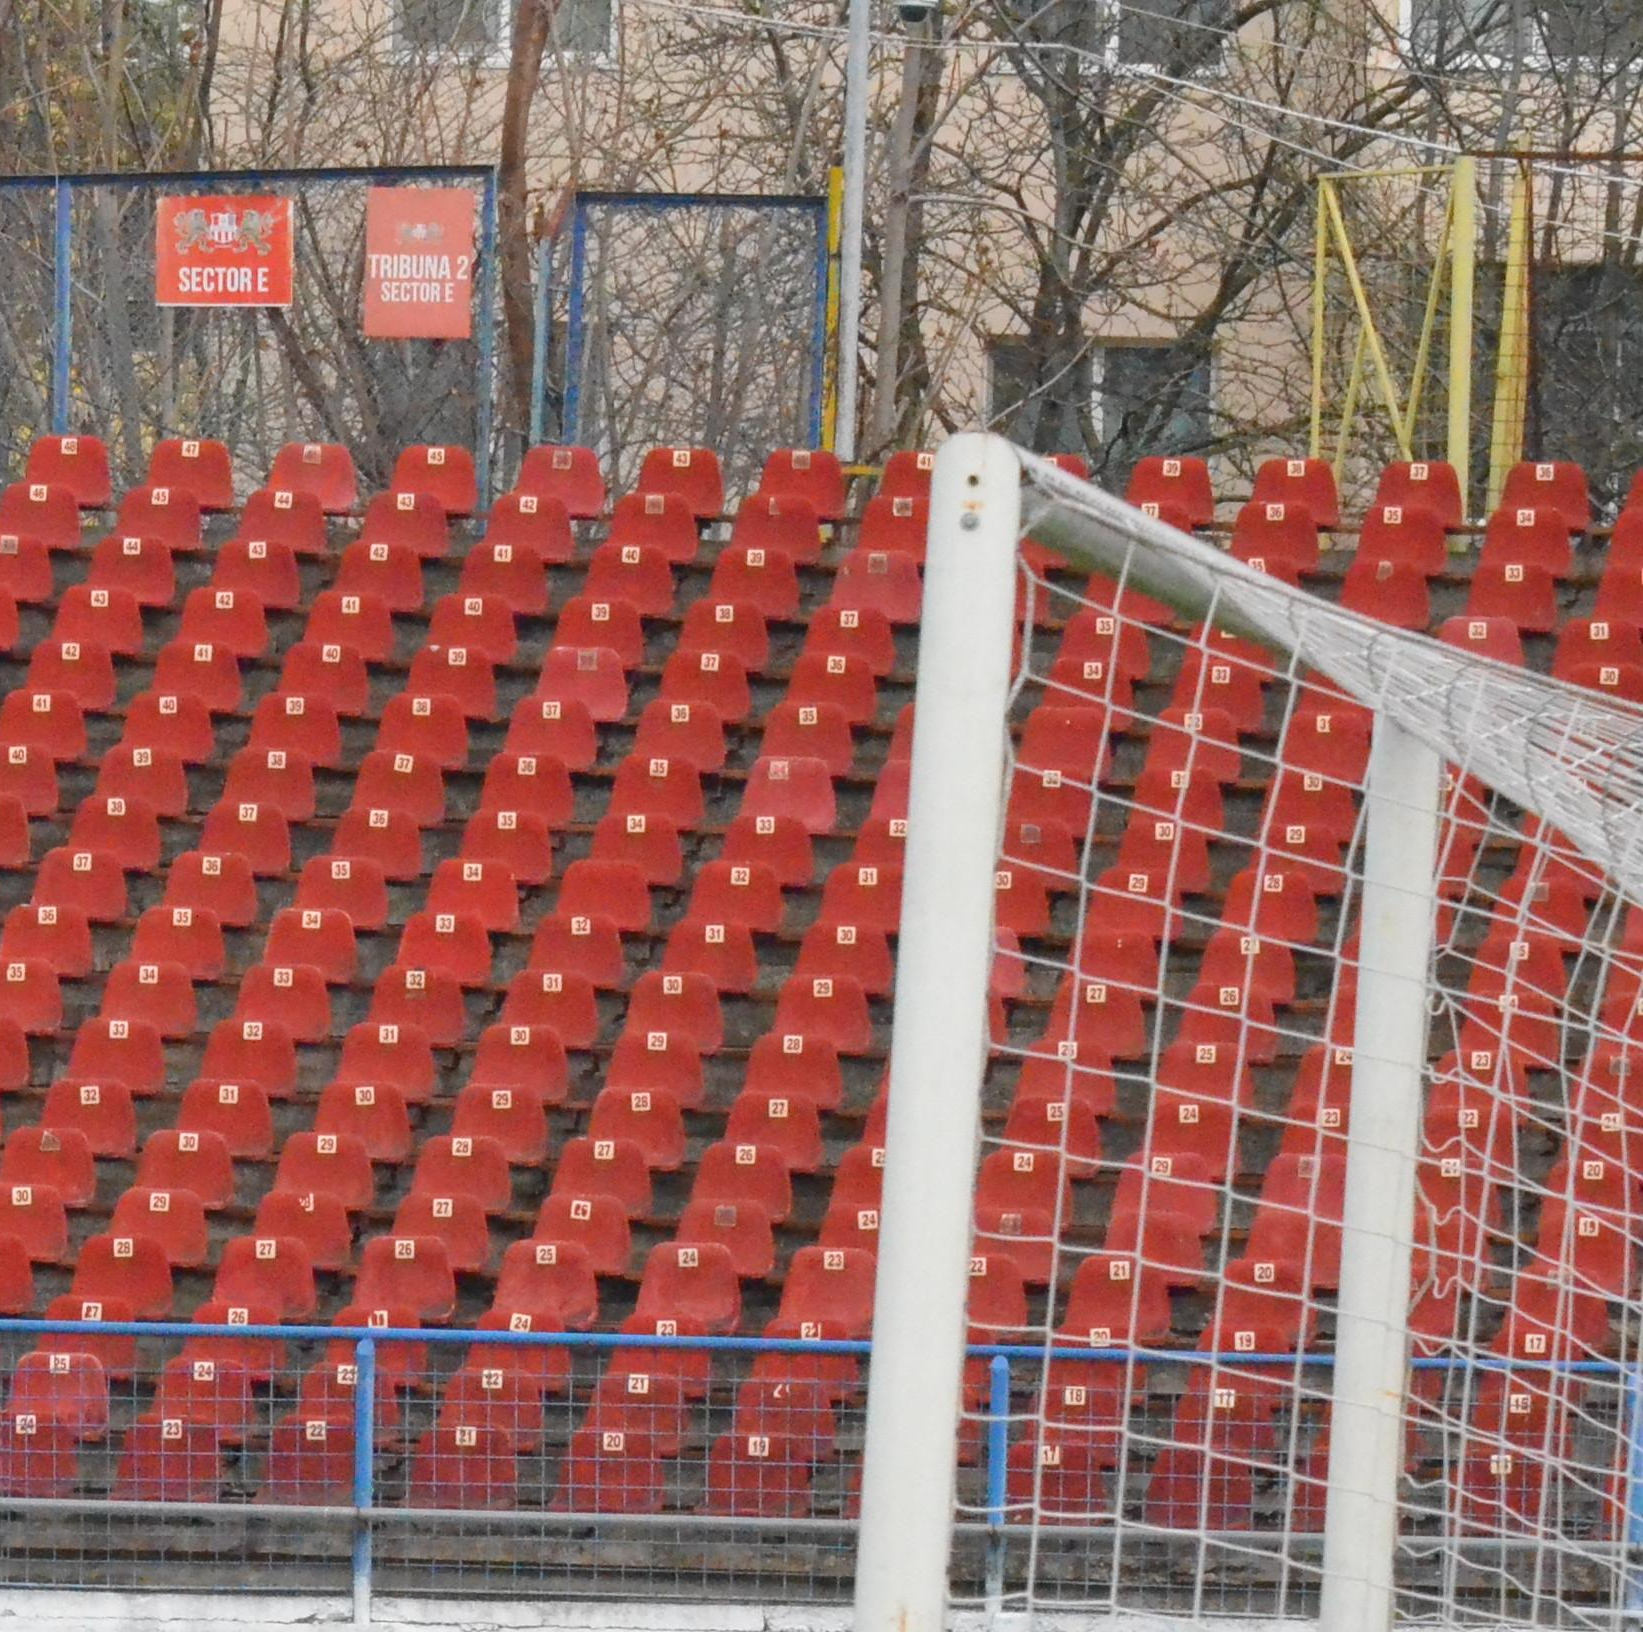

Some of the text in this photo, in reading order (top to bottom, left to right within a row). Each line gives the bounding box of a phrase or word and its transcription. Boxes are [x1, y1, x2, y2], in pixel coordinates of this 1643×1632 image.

[368, 253, 469, 280] TRIBUNA 2
[178, 266, 269, 294] SECTOR E
[380, 282, 454, 303] SECTOR E
[1165, 462, 1179, 475] 39
[1269, 506, 1283, 519] 36
[1519, 512, 1533, 524] 34
[125, 541, 139, 552] 44
[373, 546, 385, 559] 42
[625, 549, 637, 562] 40
[1507, 567, 1521, 580] 33
[218, 594, 231, 606] 42
[595, 606, 608, 619] 39
[1593, 625, 1605, 638] 31
[197, 647, 209, 659] 41
[451, 650, 465, 664] 39
[829, 658, 843, 671] 36
[1215, 668, 1227, 682] 33
[1603, 670, 1617, 684] 30
[162, 699, 175, 712] 40
[674, 707, 687, 720] 36
[11, 748, 25, 762] 40
[271, 754, 283, 767] 38
[521, 760, 534, 773] 36
[111, 800, 123, 814] 38
[372, 812, 386, 826] 36
[629, 817, 643, 830] 34
[1289, 828, 1303, 842] 29
[205, 859, 219, 873] 36
[466, 866, 479, 879] 34
[861, 870, 874, 884] 31
[175, 911, 189, 924] 35
[439, 917, 452, 931] 33
[708, 927, 721, 941] 31
[141, 968, 156, 982] 34
[666, 978, 680, 992] 30
[1223, 990, 1237, 1003] 26
[246, 1024, 260, 1038] 32
[513, 1029, 527, 1043] 30
[786, 1038, 801, 1052] 28
[222, 1088, 235, 1102] 31
[495, 1092, 509, 1107] 29
[771, 1102, 785, 1115] 27
[1182, 1107, 1197, 1121] 24
[319, 1138, 335, 1152] 29
[597, 1144, 611, 1158] 27
[15, 1189, 29, 1203] 30
[435, 1201, 450, 1215] 27
[259, 1242, 273, 1256] 27
[539, 1248, 553, 1262] 25
[827, 1253, 843, 1268] 23
[1113, 1264, 1127, 1278] 21
[1529, 1336, 1543, 1350] 17
